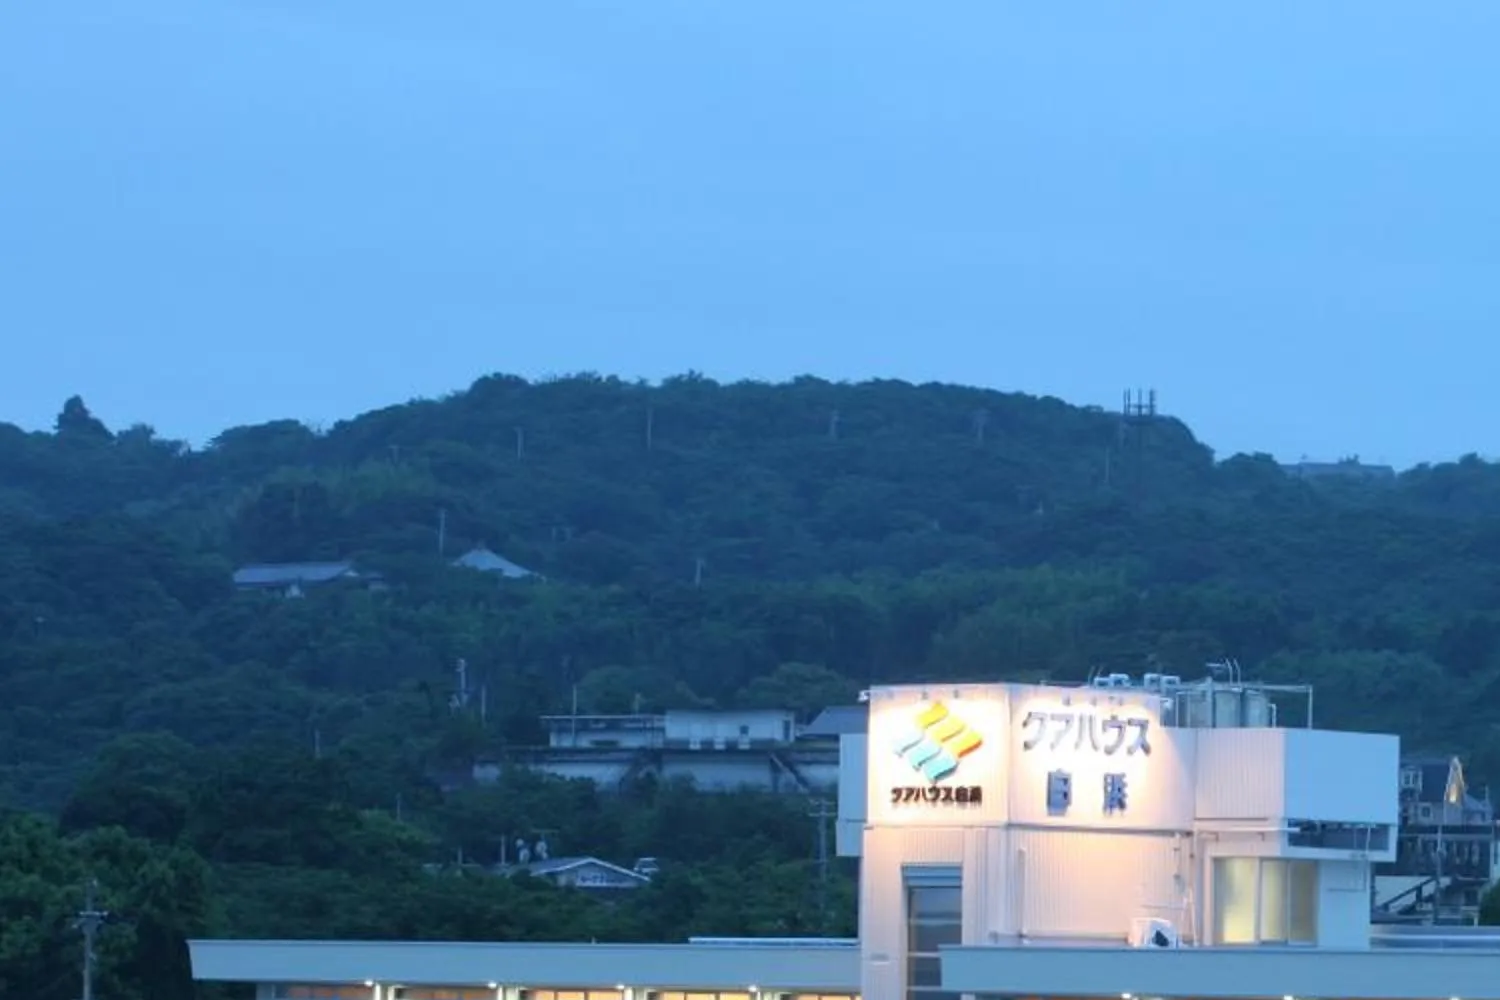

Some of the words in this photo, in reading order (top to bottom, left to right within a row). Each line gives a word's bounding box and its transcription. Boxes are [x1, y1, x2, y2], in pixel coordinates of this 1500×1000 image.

[1022, 711, 1151, 756] クアハウス
